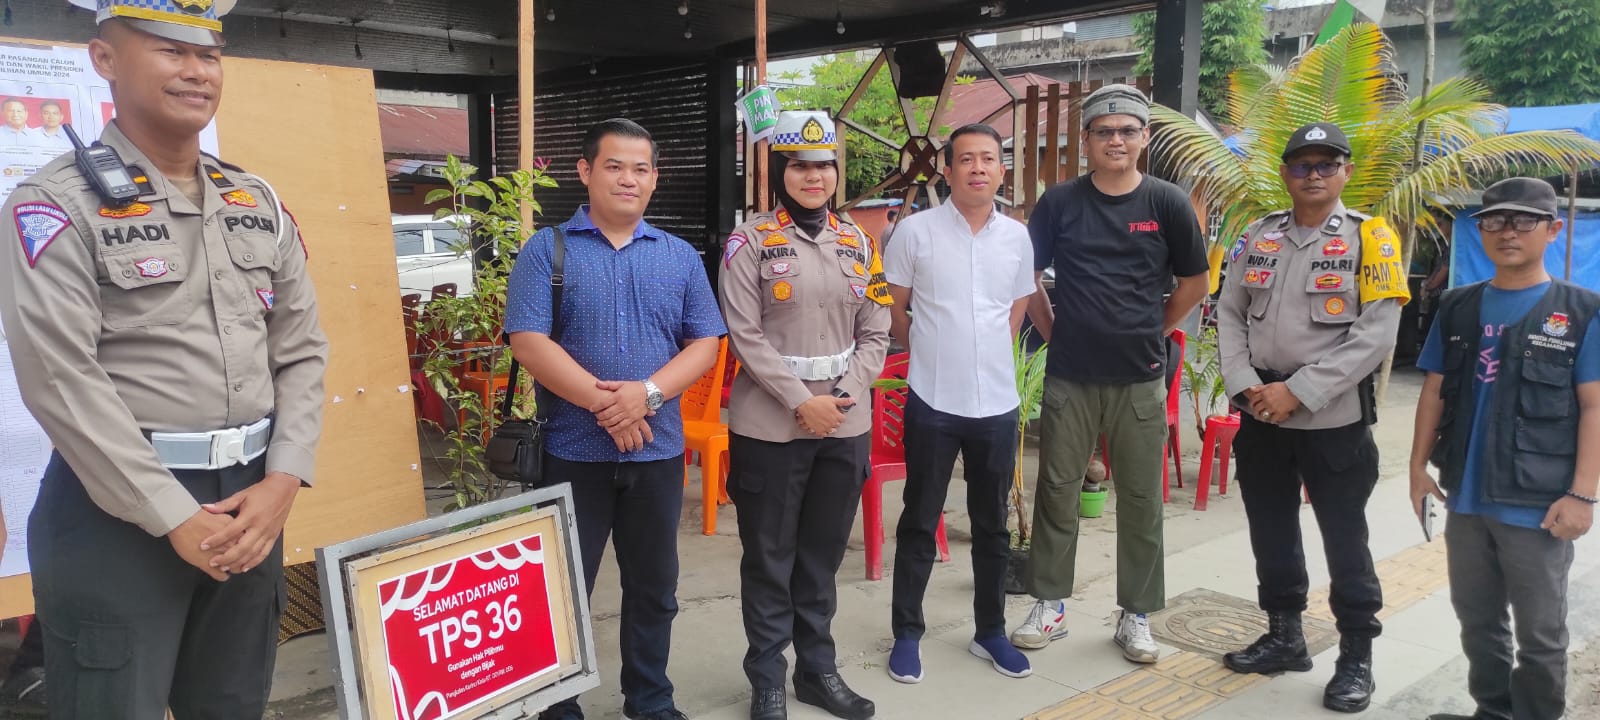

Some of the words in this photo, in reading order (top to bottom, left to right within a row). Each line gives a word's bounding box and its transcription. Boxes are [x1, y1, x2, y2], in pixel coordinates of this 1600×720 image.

[8, 55, 49, 64] PASANGAN
[50, 58, 75, 66] CALON
[50, 65, 84, 73] PRESIDEN
[27, 69, 52, 77] UMUM
[25, 85, 33, 95] 2
[224, 214, 275, 234] POLRI
[101, 223, 170, 247] HADI
[760, 246, 798, 262] AKIRA
[1311, 259, 1353, 271] POLRI
[1363, 262, 1391, 286] PAM
[413, 591, 465, 622] SELAMAT
[465, 576, 509, 603] DATANG
[509, 572, 520, 586] DI
[418, 609, 482, 664] TPS
[485, 594, 522, 640] 36
[447, 657, 473, 673] Gunakan
[472, 651, 484, 662] Hak
[460, 665, 482, 680] dengan
[481, 658, 496, 672] Bijak
